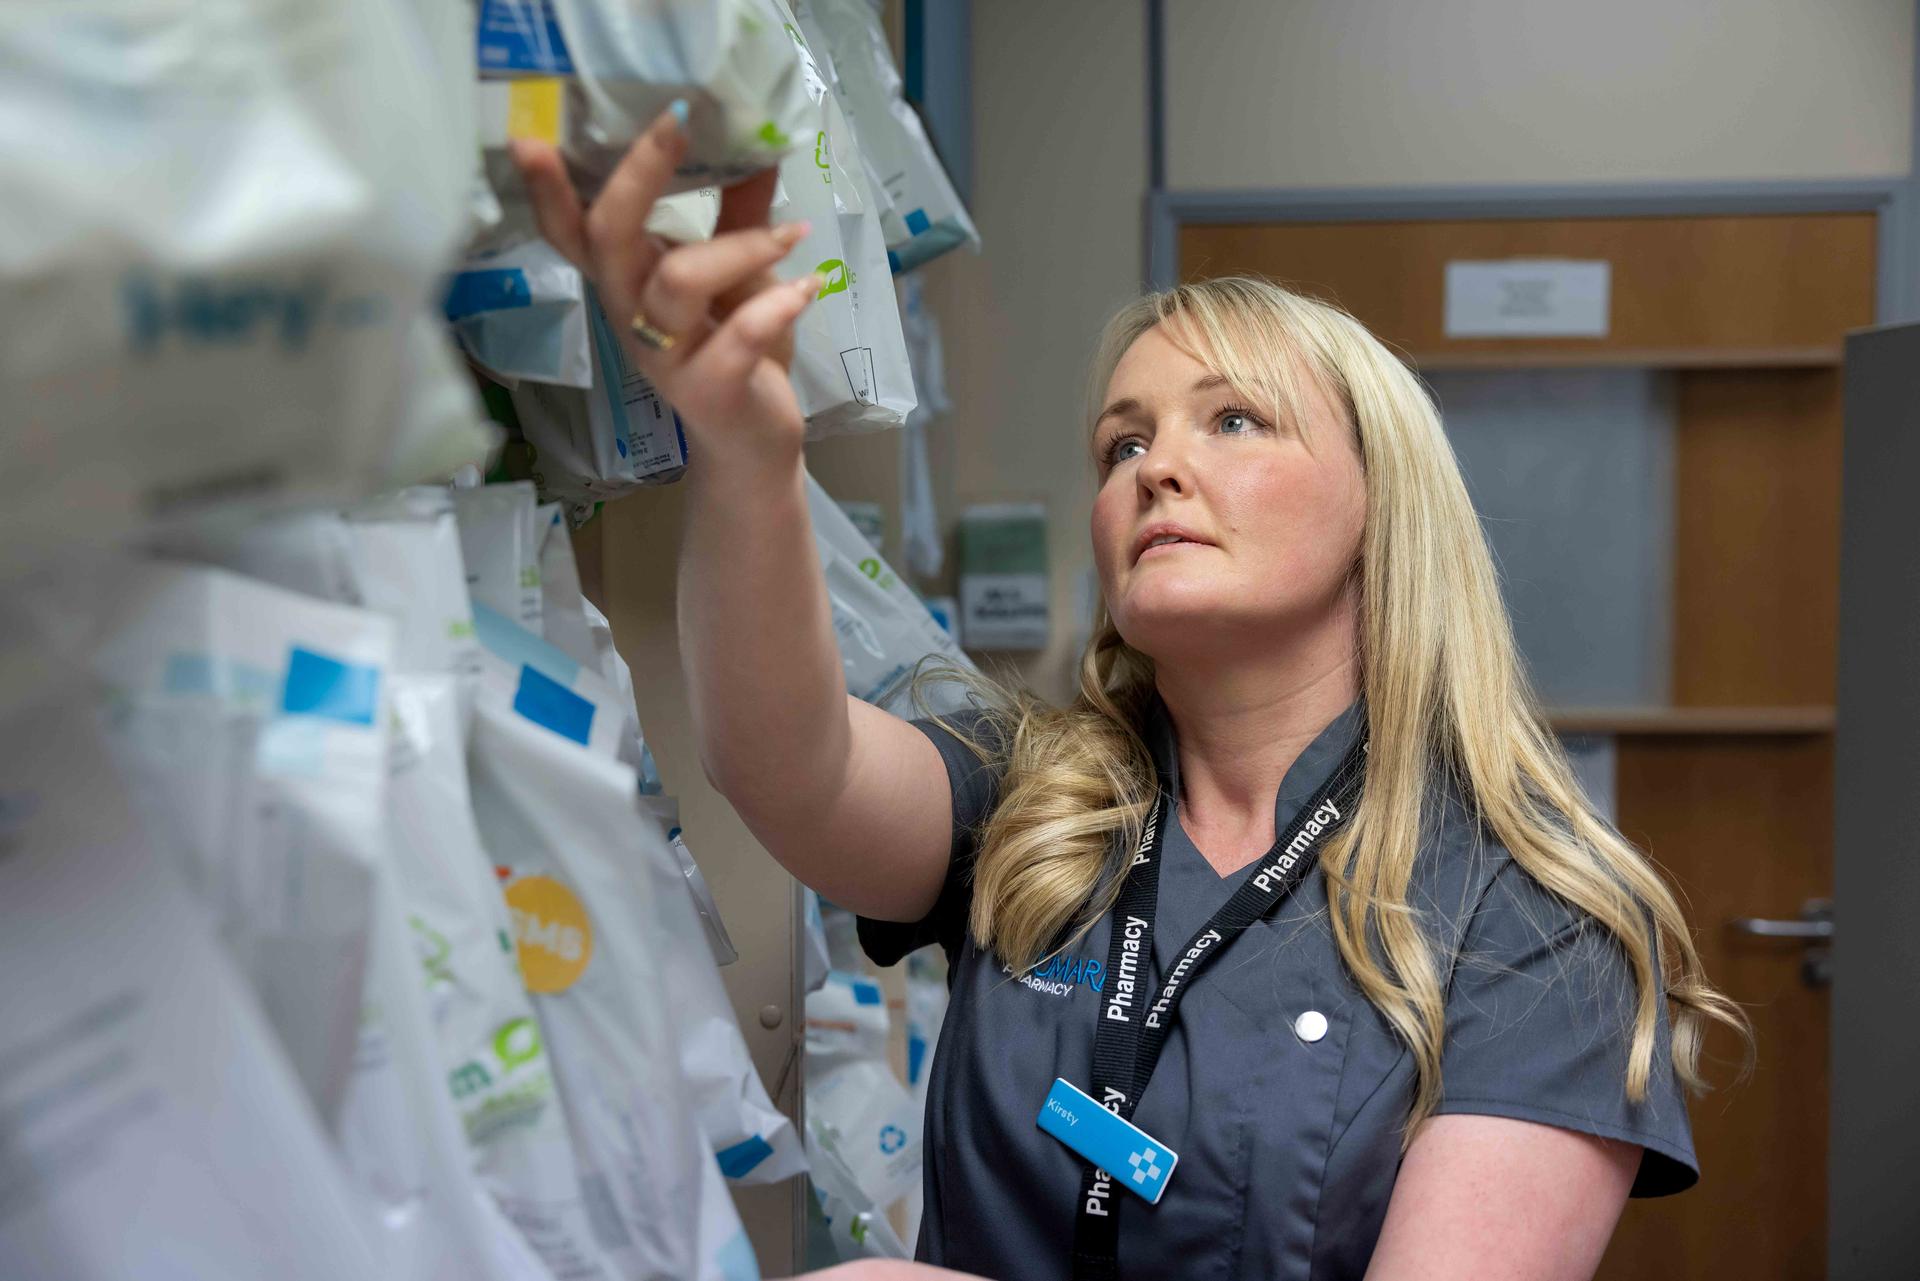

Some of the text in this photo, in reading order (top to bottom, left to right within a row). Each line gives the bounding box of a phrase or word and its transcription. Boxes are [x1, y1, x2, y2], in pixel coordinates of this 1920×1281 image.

[1252, 799, 1341, 893] Pharmacy
[1002, 963, 1074, 997] PARMACY
[1033, 953, 1107, 993] UMAR
[1106, 916, 1148, 1022] Pharmacy
[1145, 929, 1222, 1028] Pharmacy
[1047, 1098, 1079, 1126] Kirsty
